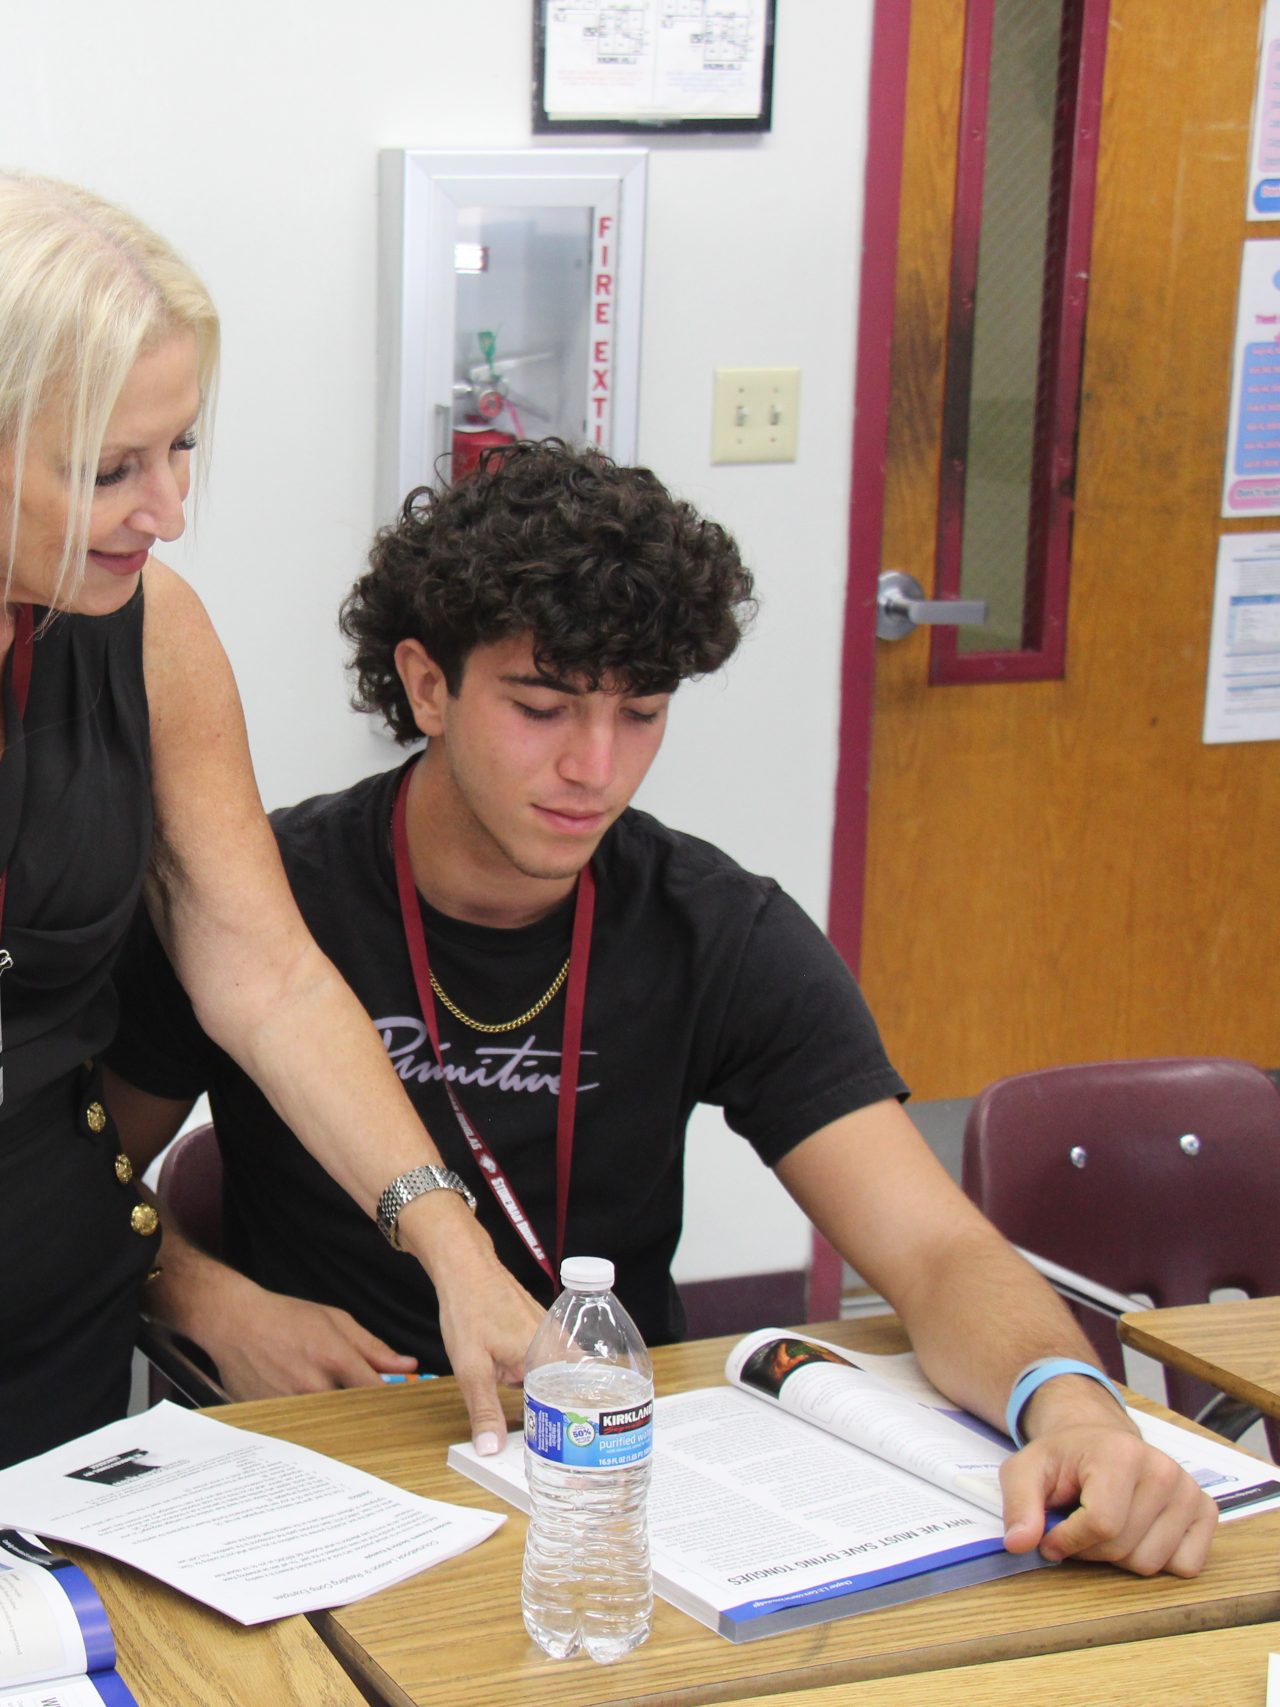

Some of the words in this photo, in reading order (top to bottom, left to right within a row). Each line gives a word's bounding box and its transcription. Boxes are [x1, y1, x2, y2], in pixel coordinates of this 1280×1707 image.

[594, 216, 614, 325] FIRE
[592, 341, 610, 446] EXTI
[375, 1016, 600, 1095] Primitive
[603, 1404, 653, 1427] KIRKLAND
[573, 1428, 592, 1438] 50%
[599, 1435, 636, 1451] purified
[922, 1523, 941, 1534] WE
[881, 1529, 920, 1547] MUST
[843, 1542, 880, 1558] SAVE
[799, 1552, 841, 1570] DYING
[727, 1562, 798, 1586] TONGUES
